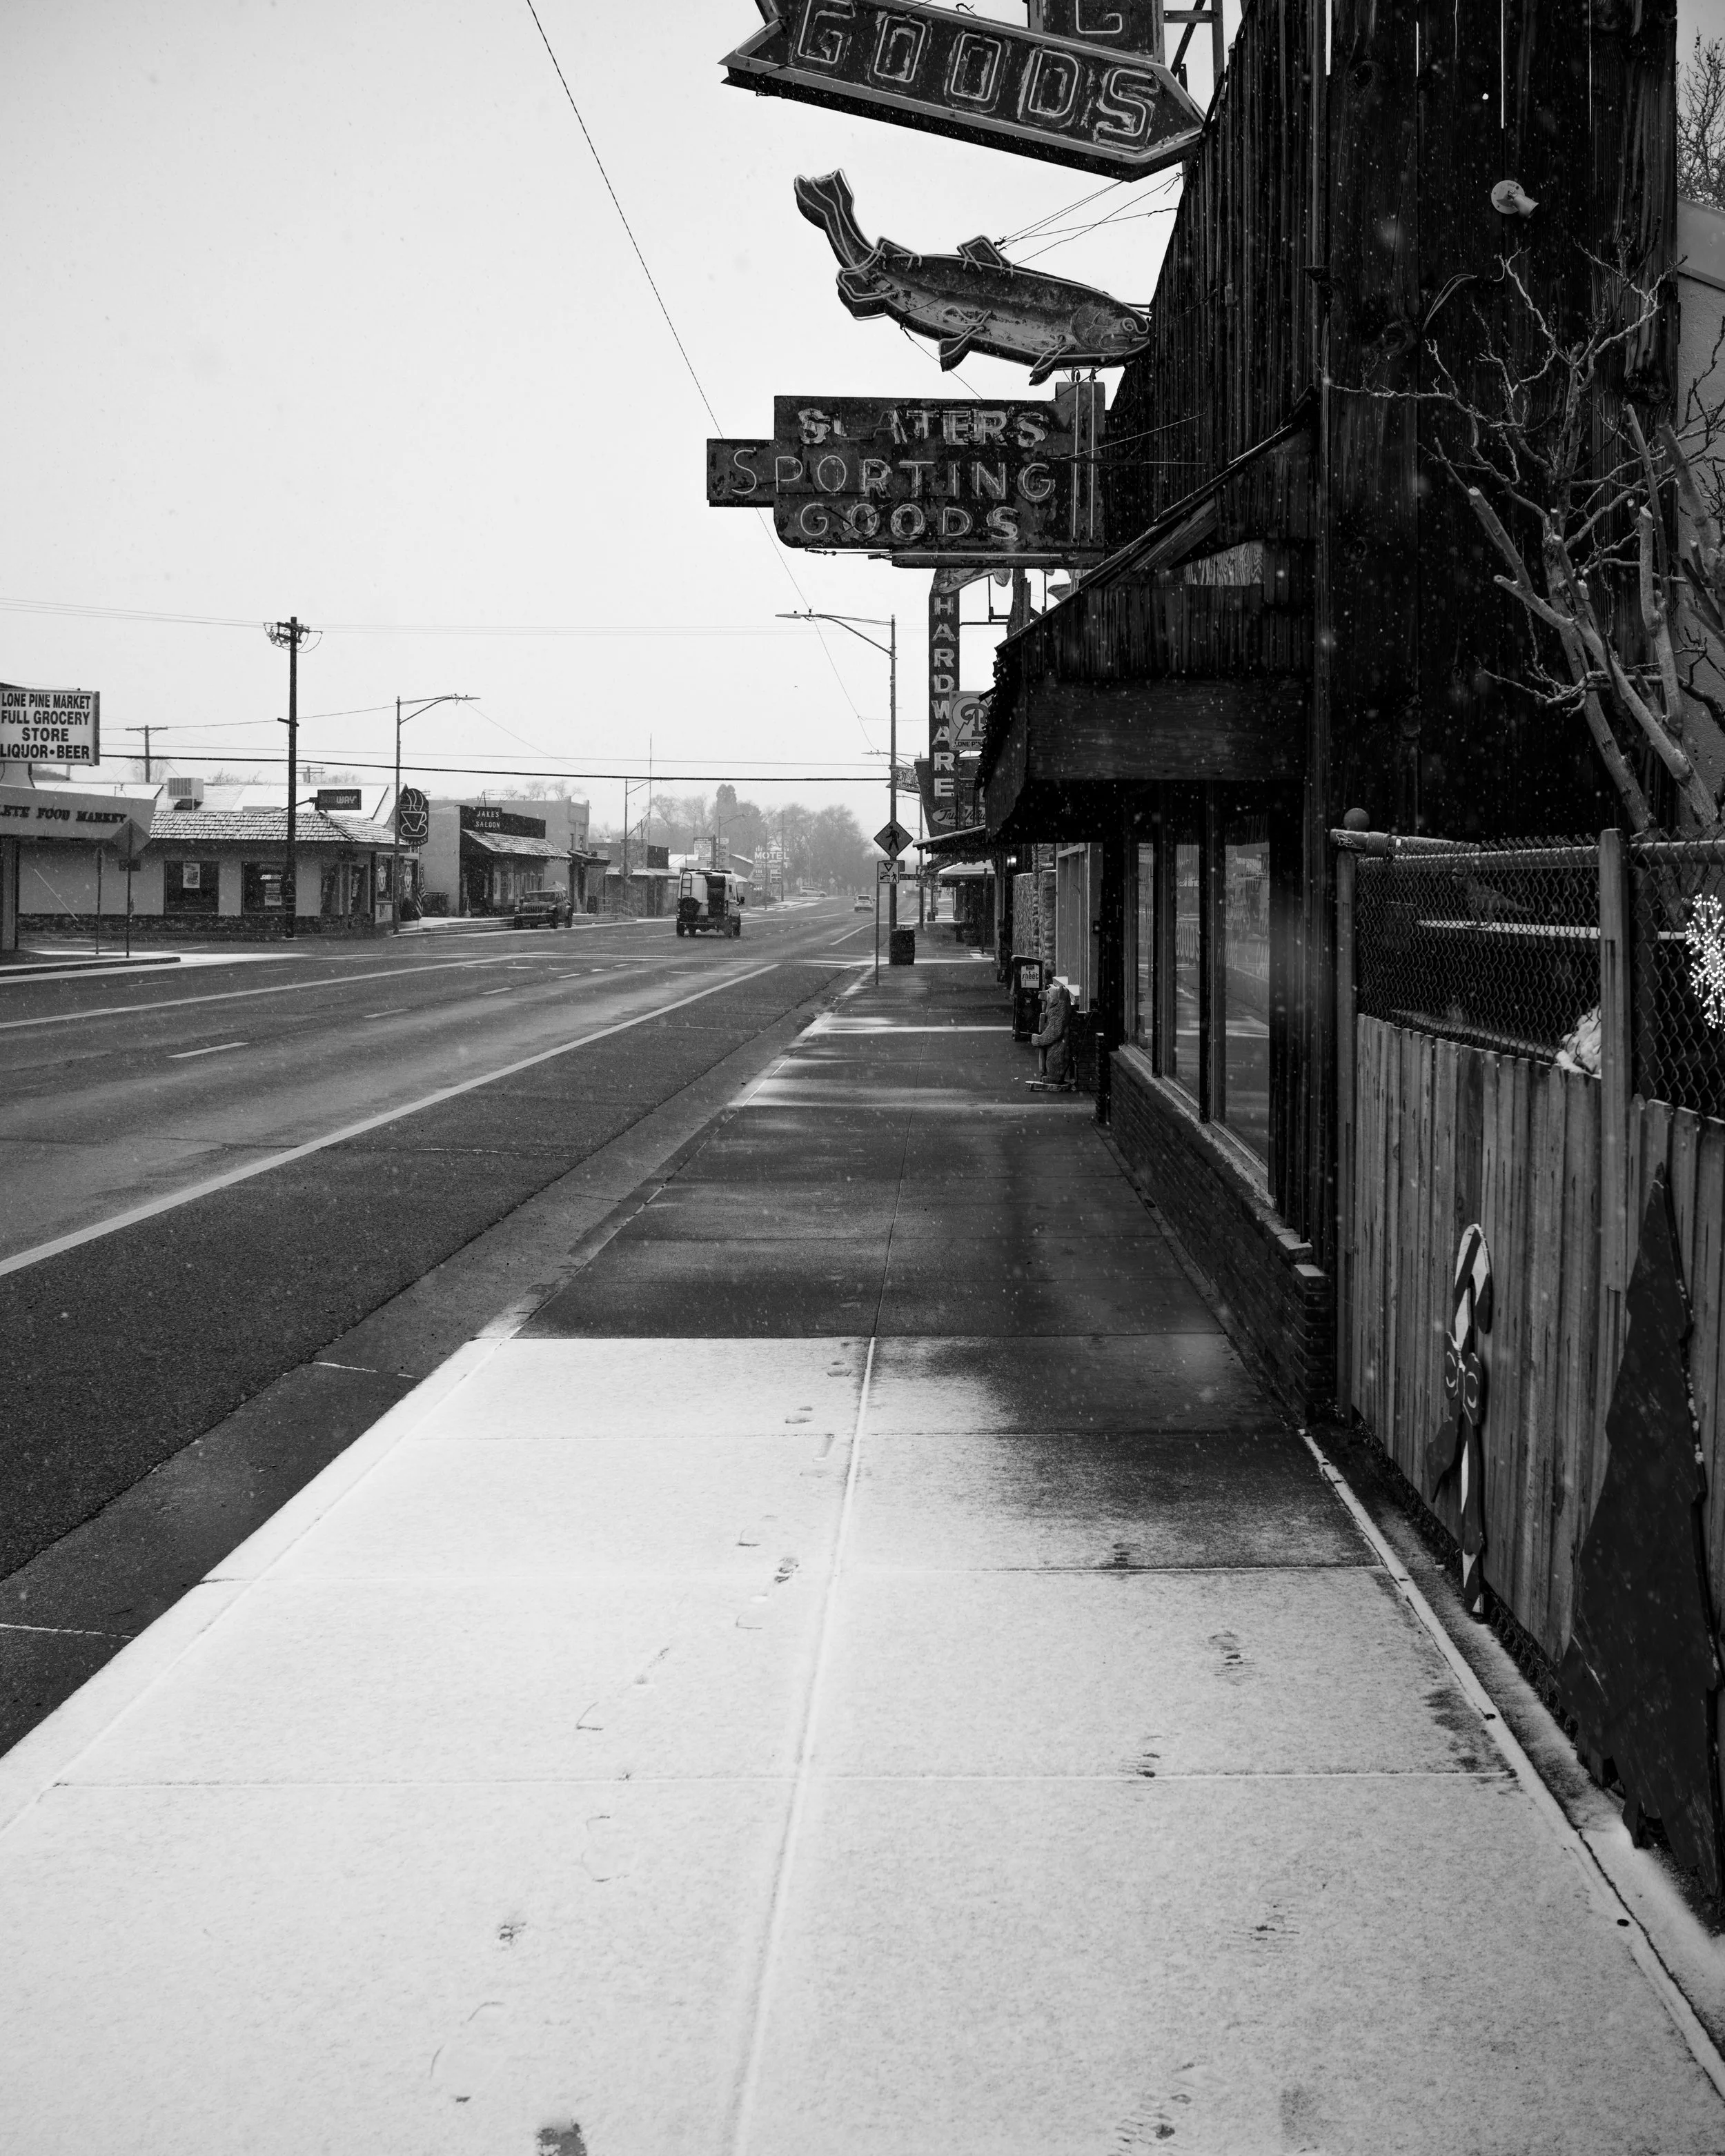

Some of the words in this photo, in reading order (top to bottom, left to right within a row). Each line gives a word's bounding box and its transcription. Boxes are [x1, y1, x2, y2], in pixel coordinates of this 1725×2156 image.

[790, 0, 1159, 149] GOODS
[731, 447, 1055, 502] SPORTING
[800, 503, 1021, 541] GOODS
[2, 693, 26, 707] LONE
[29, 693, 50, 708] PINE
[53, 695, 91, 709] MARKET
[931, 597, 956, 797] HARDWARE
[1, 710, 30, 724] FULL
[33, 711, 90, 725] GROCERY
[22, 727, 69, 742] STORE
[0, 744, 48, 758] LIQUOR
[57, 745, 90, 759] BEER
[36, 807, 70, 820] FOOD
[76, 810, 128, 824] MARKET
[938, 809, 958, 821] Tru
[754, 851, 789, 860] MOTEL
